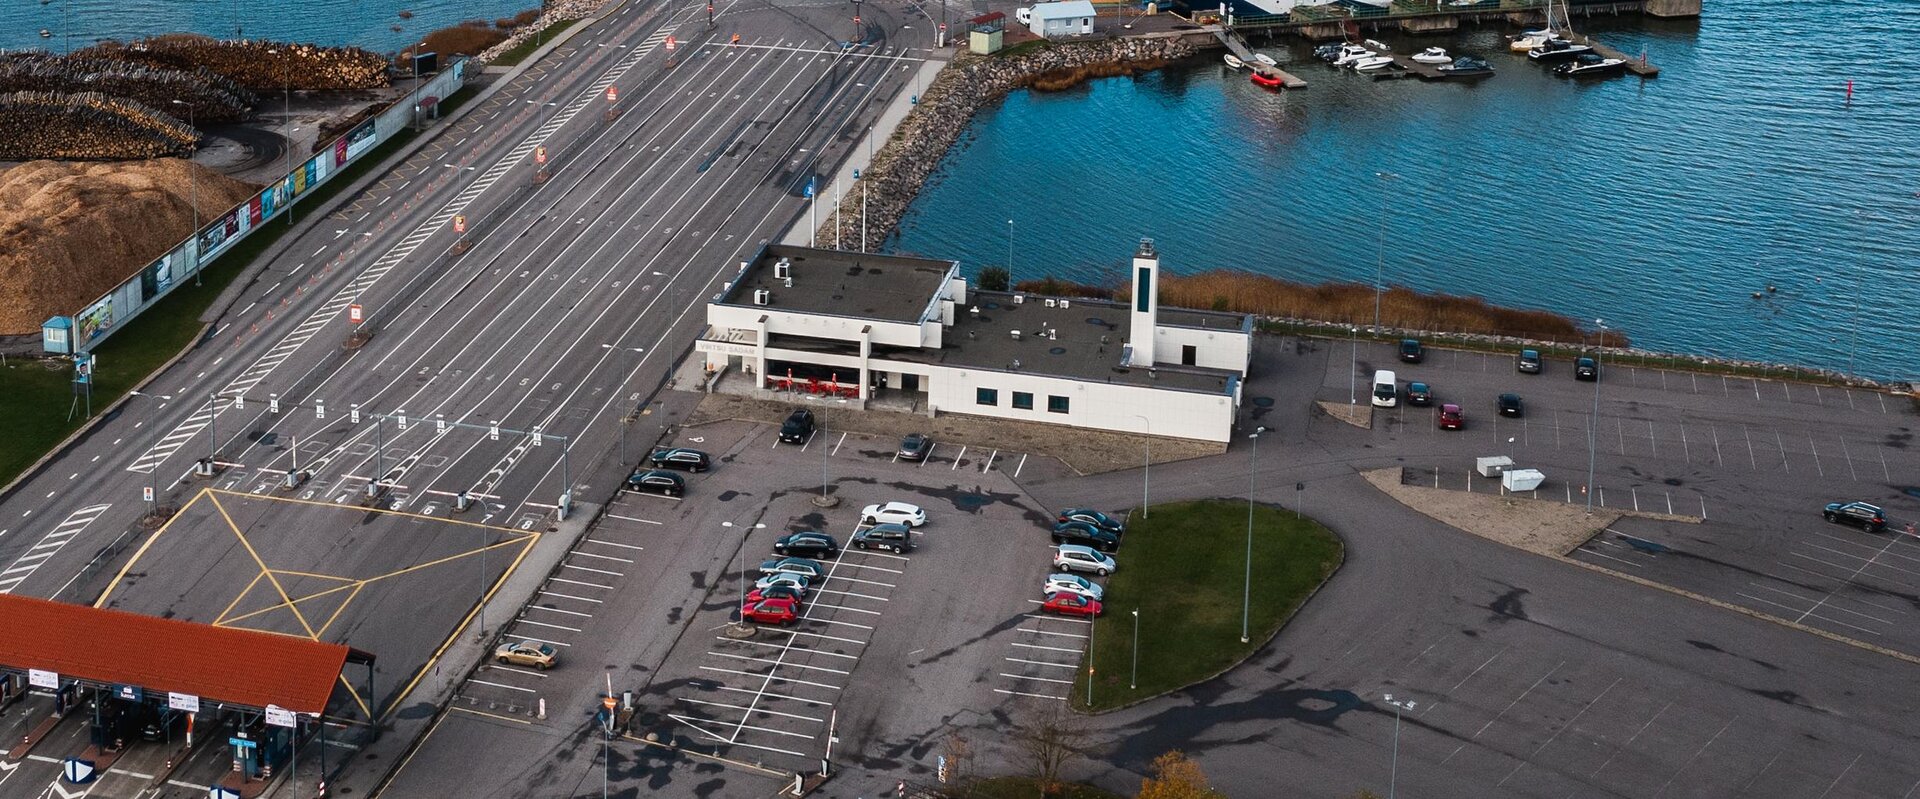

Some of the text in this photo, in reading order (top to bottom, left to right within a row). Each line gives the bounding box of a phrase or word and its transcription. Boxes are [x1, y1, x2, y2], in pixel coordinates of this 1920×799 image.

[519, 270, 530, 278] 2
[611, 280, 622, 288] 5
[641, 284, 651, 292] 6
[418, 366, 430, 375] 2
[519, 378, 530, 386] 5
[551, 382, 562, 391] 6
[591, 387, 603, 396] 7
[629, 392, 640, 401] 8
[224, 480, 235, 490] 1
[253, 484, 267, 494] 2
[302, 490, 315, 500] 3
[335, 494, 347, 504] 4
[390, 500, 403, 511] 5
[423, 505, 436, 515] 6
[481, 514, 494, 524] 7
[521, 520, 533, 530] 8
